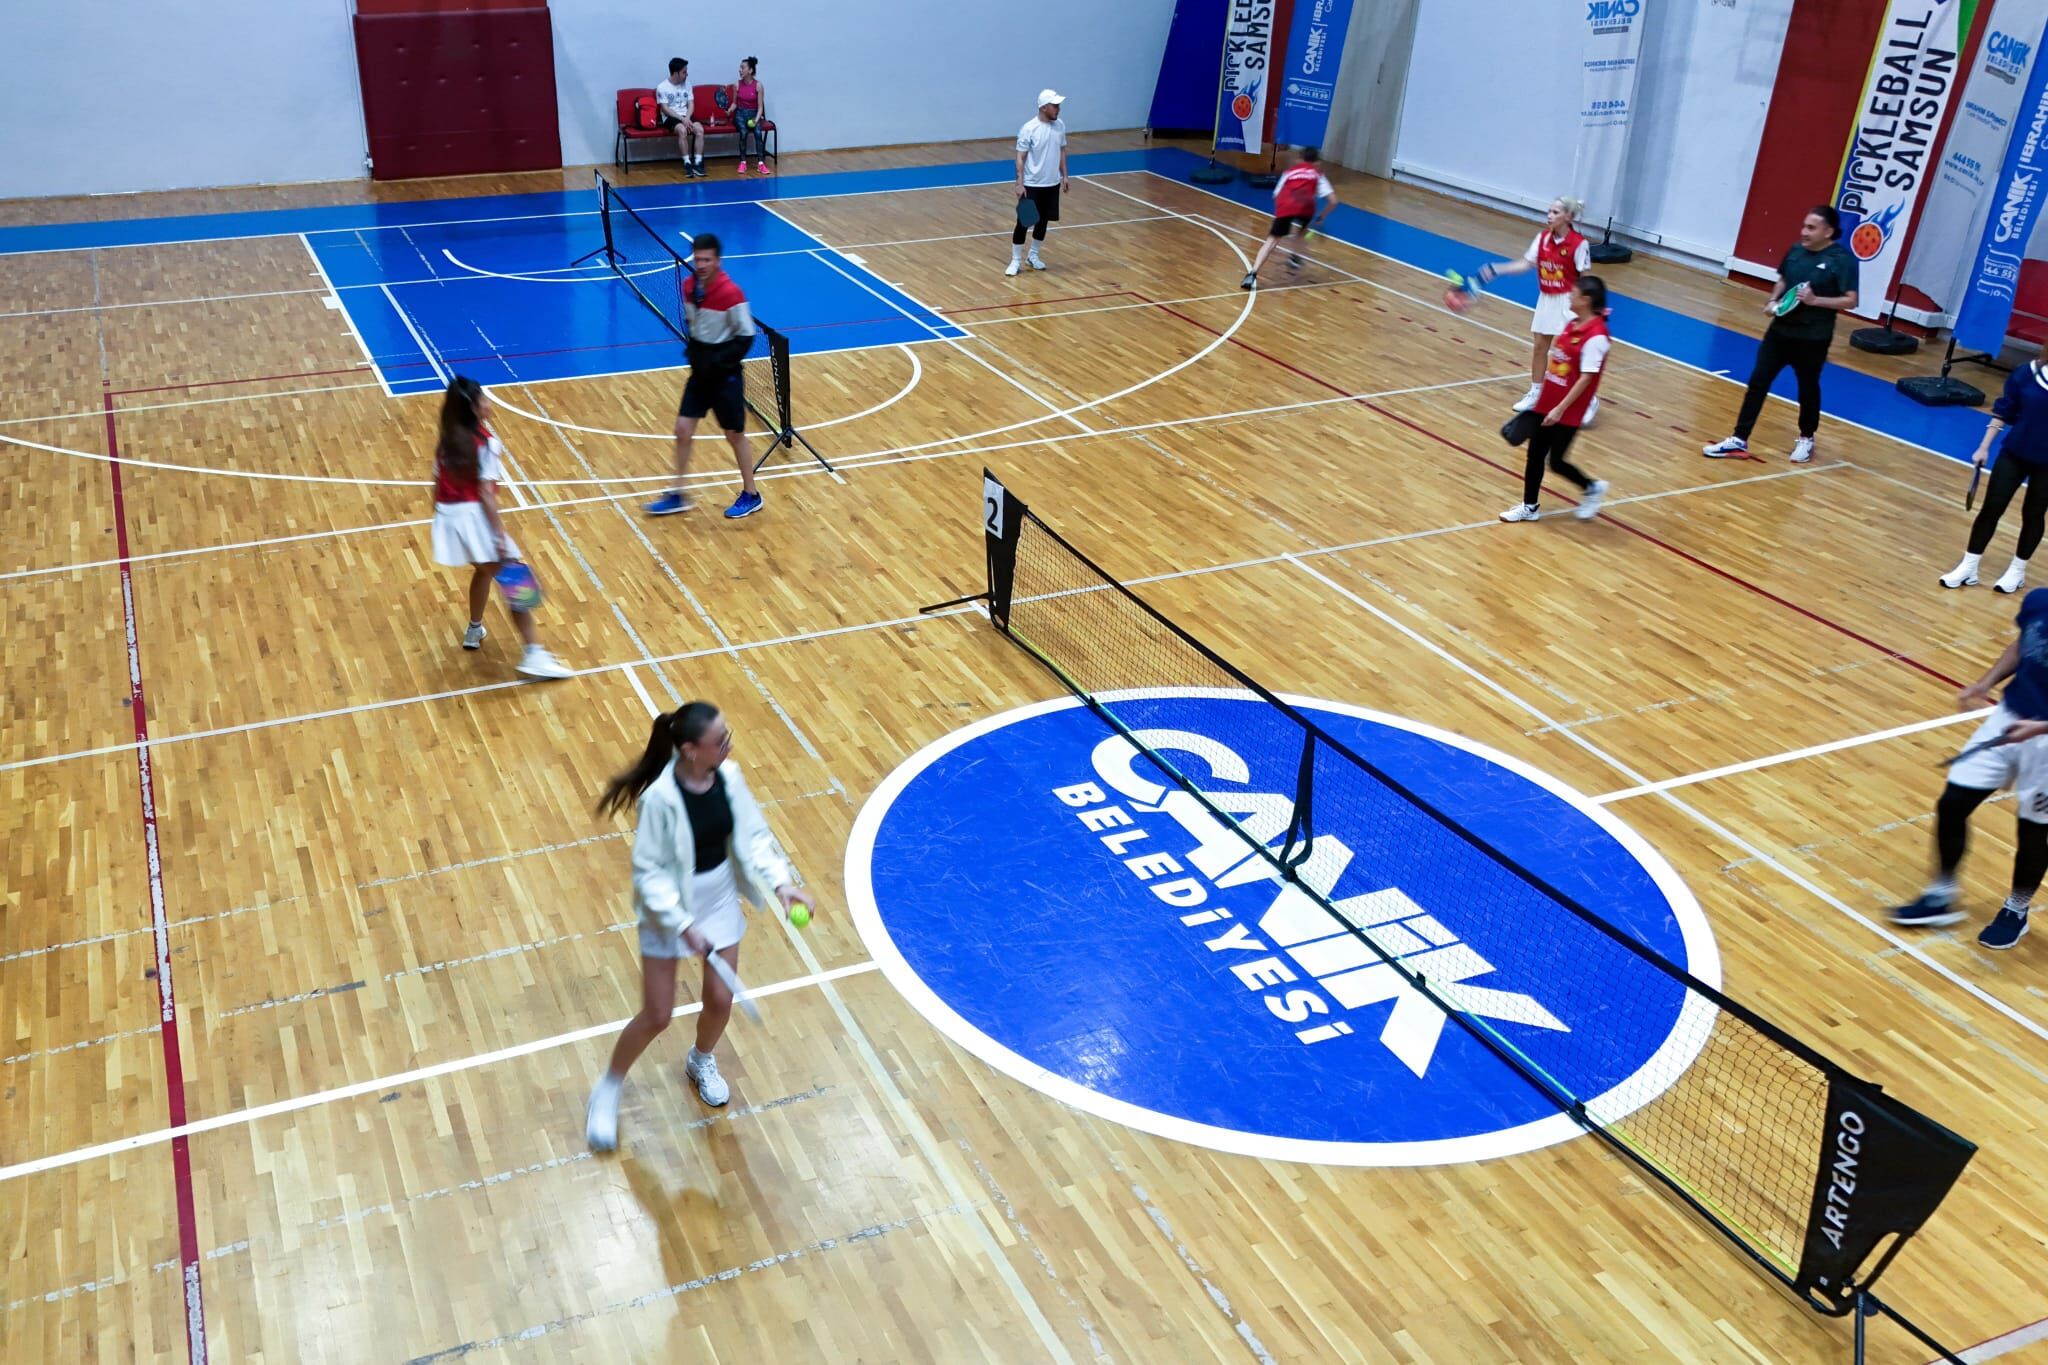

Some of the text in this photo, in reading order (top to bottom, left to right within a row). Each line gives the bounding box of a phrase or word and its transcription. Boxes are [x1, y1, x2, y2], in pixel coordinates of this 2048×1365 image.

[1841, 10, 1933, 215] PICKLEBALL
[1884, 47, 1957, 191] SAMSUN
[987, 497, 999, 532] 2
[1820, 1111, 1866, 1250] ARTENGO
